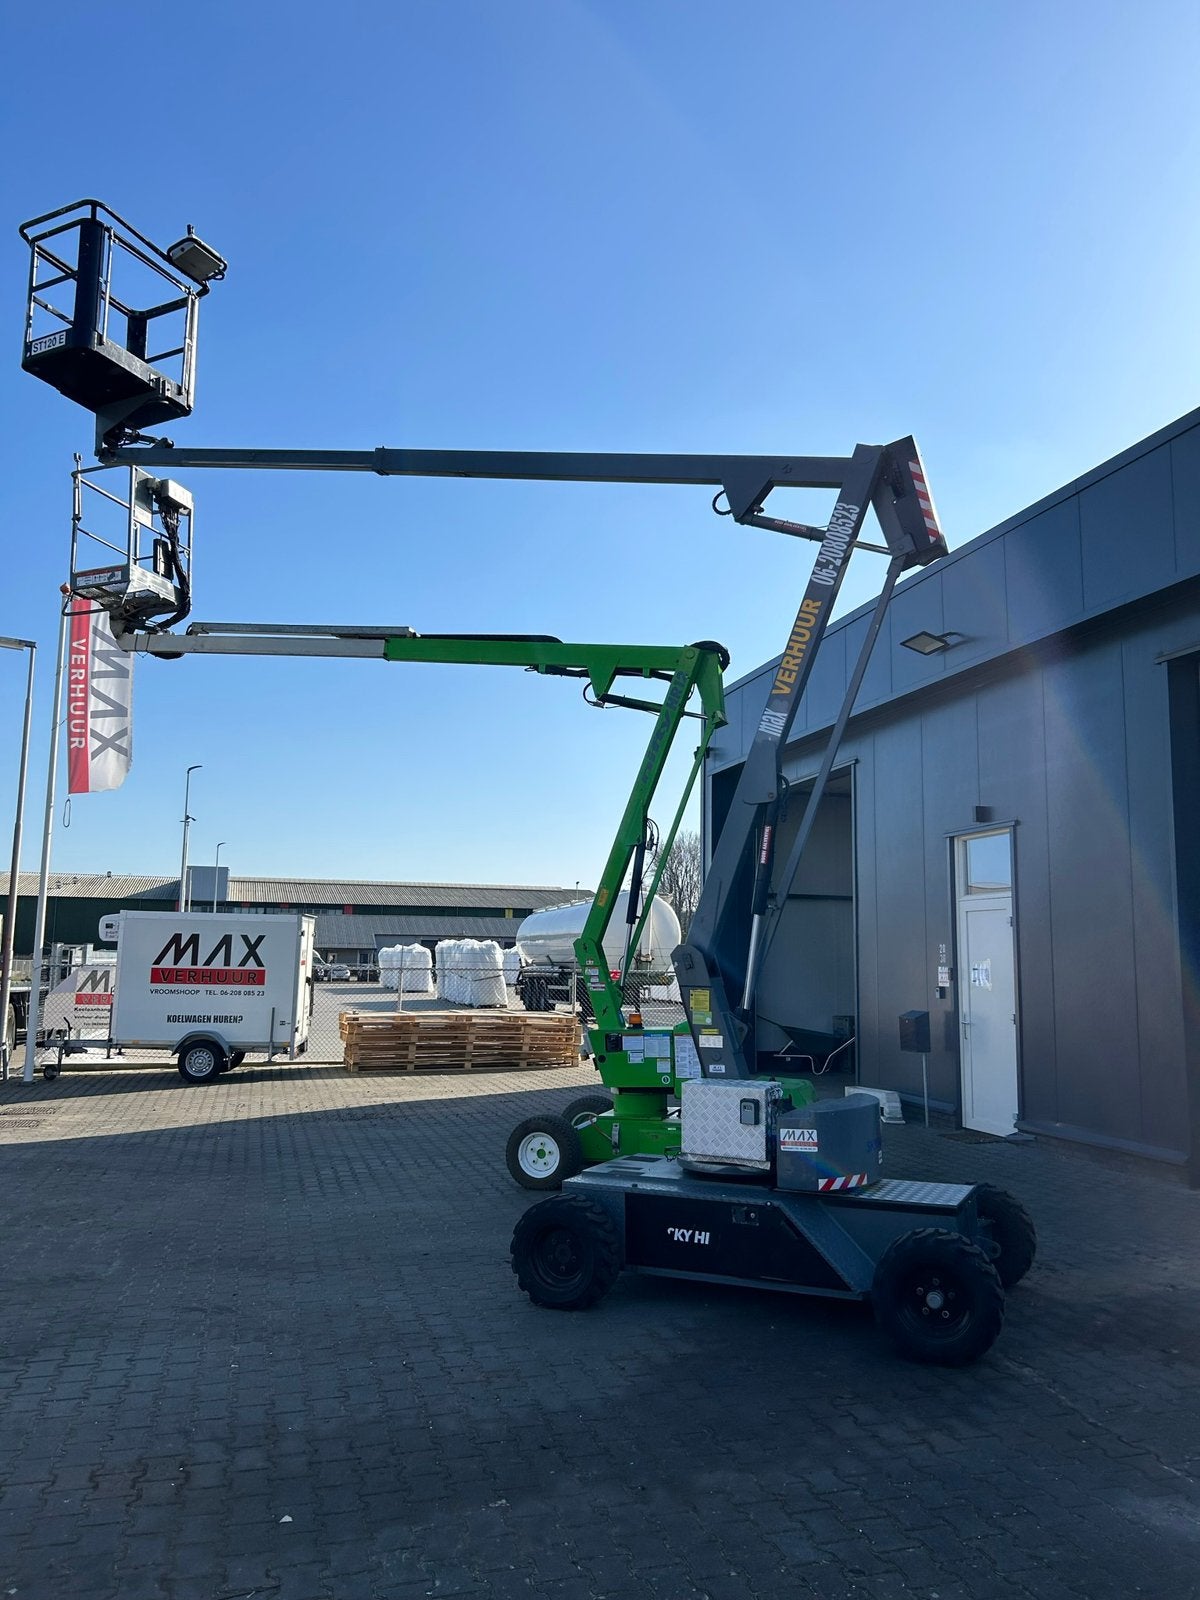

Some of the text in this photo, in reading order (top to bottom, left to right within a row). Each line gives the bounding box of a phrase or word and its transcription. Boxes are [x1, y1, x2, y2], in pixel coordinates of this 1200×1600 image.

[32, 333, 65, 353] ST120 E
[810, 502, 859, 587] 06-20808523
[771, 598, 823, 696] VERHUUR
[69, 638, 87, 751] VERHUUR
[90, 624, 130, 762] MAX
[152, 932, 266, 968] MAX
[77, 969, 111, 992] M
[160, 969, 257, 985] VERHUUR
[82, 995, 112, 1004] VER
[149, 988, 201, 996] VROOMSHOOP
[166, 1014, 244, 1024] KOELWAGEN HUREN?
[782, 1130, 815, 1142] MAX
[693, 1230, 711, 1245] HI
